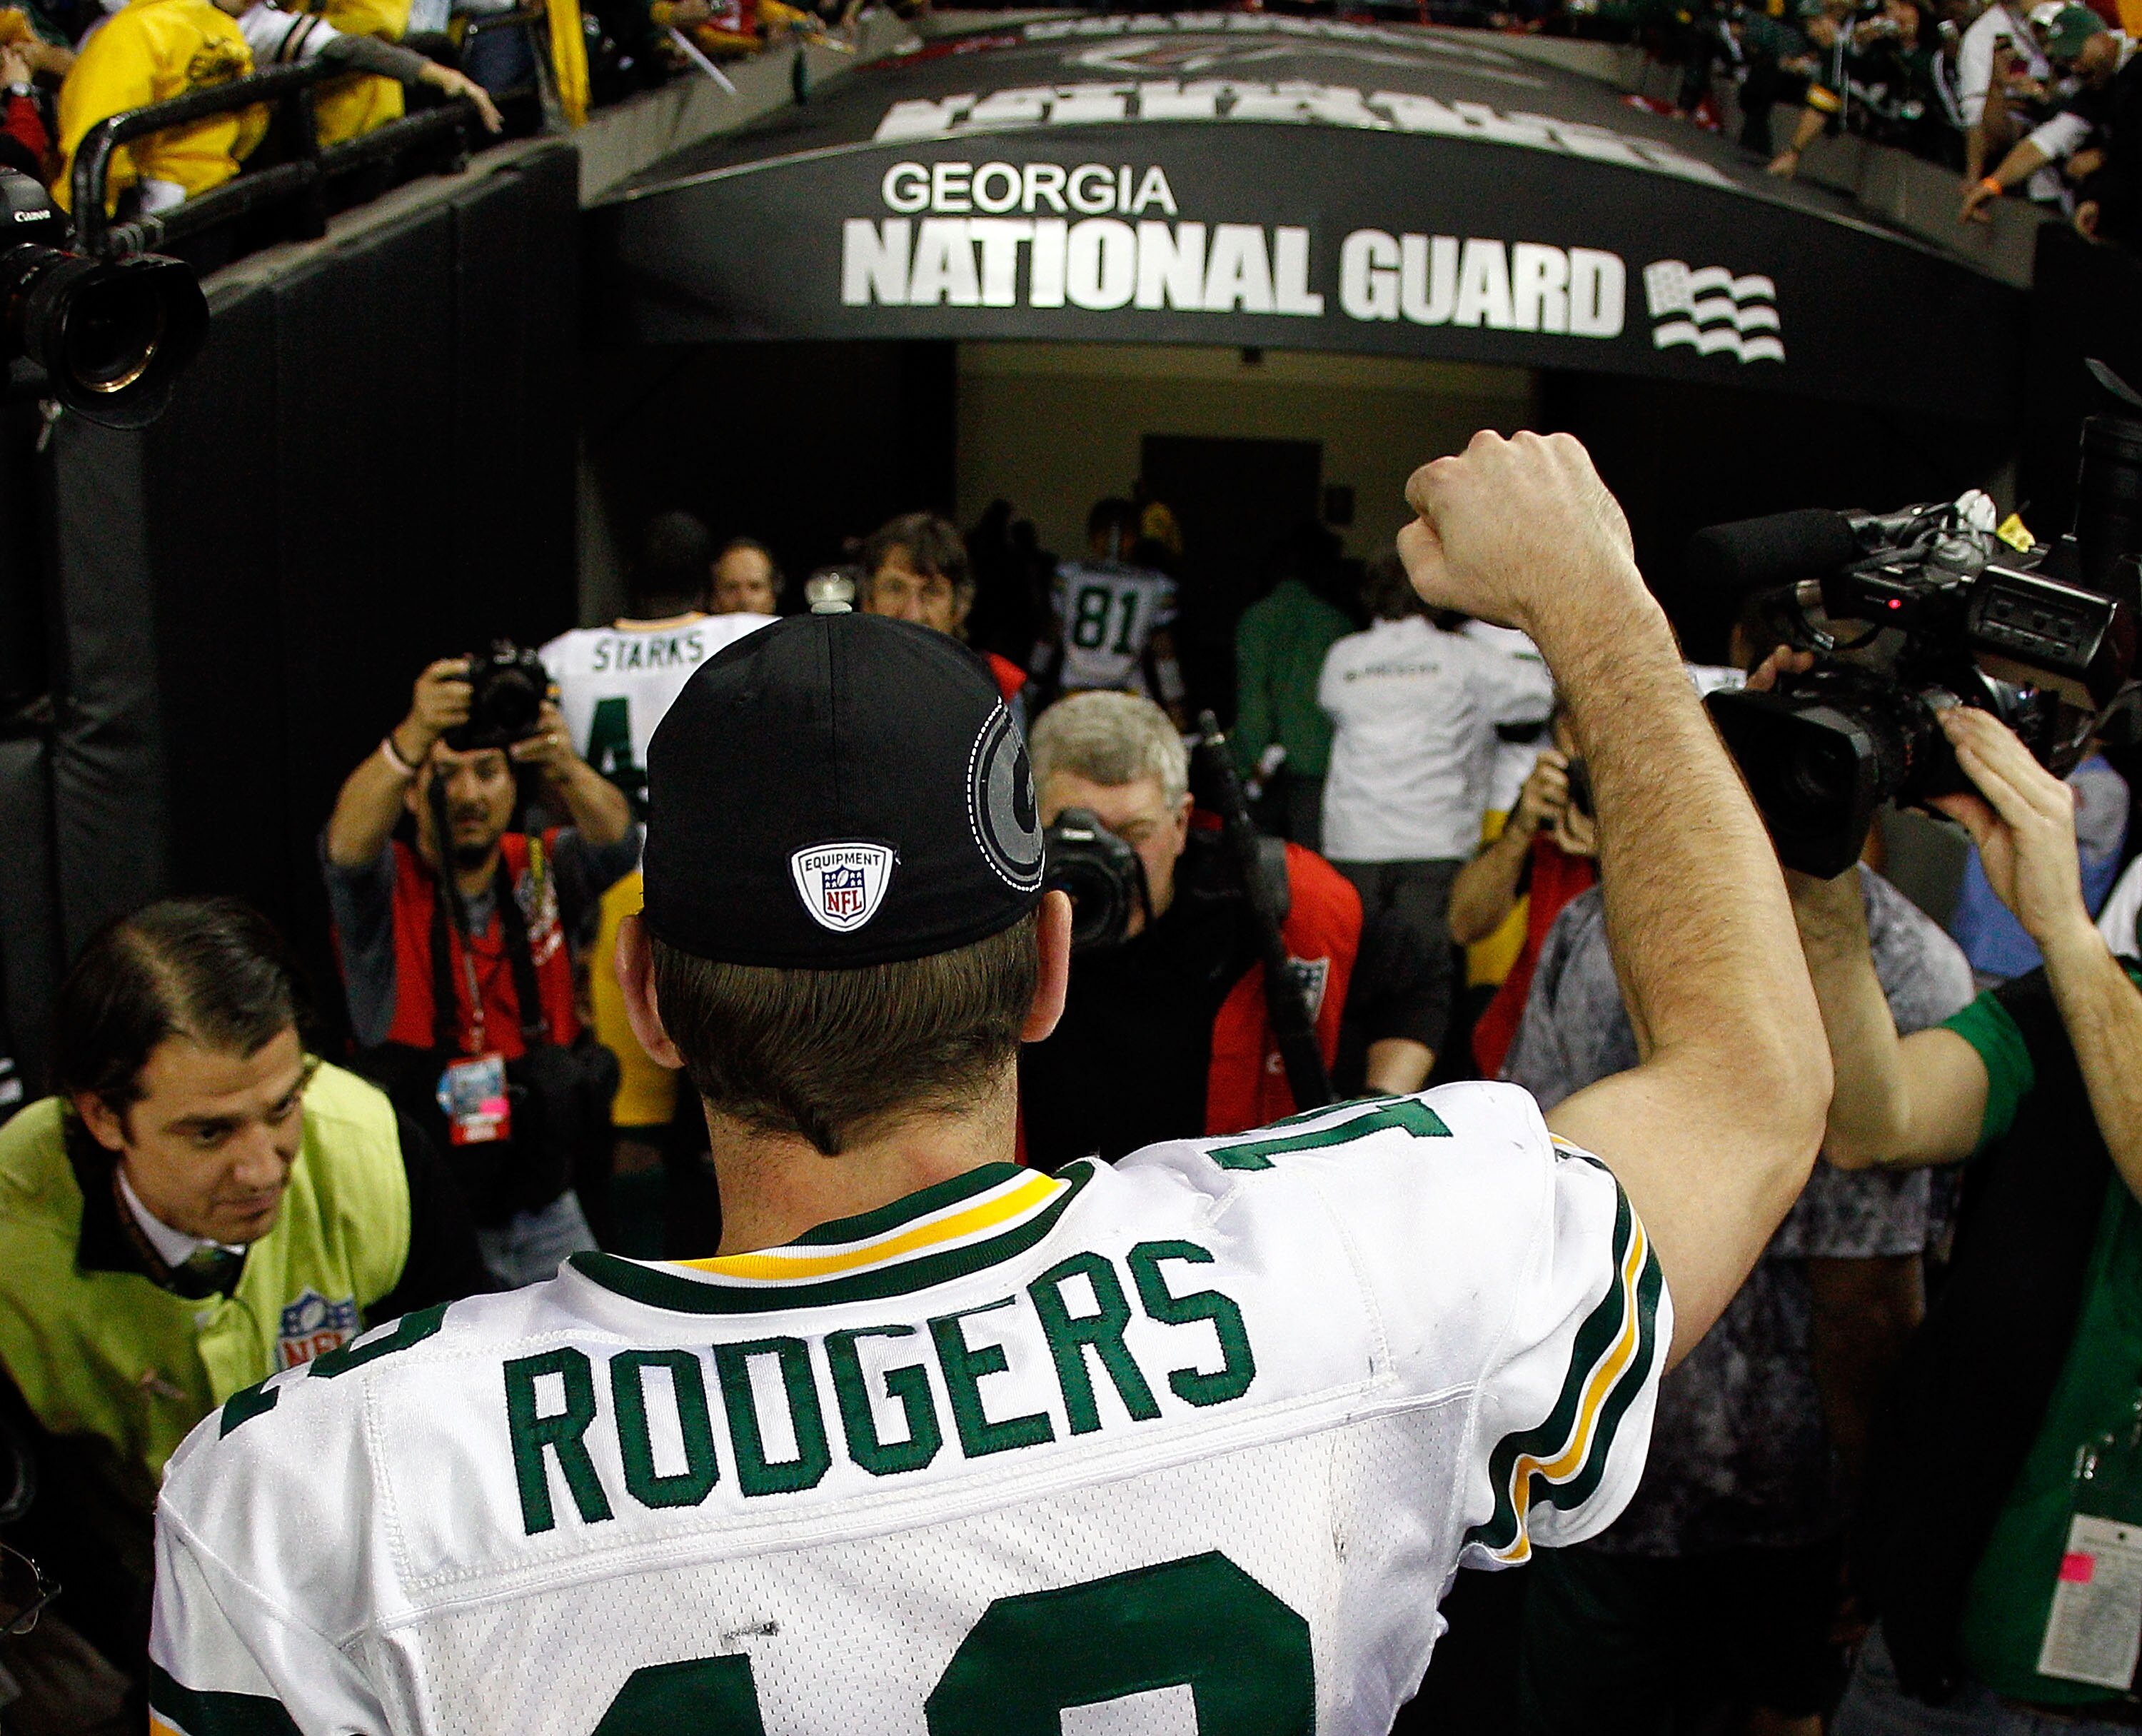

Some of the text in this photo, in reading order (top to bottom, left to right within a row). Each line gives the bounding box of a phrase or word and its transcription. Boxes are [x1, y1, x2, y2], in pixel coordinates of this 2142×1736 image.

[881, 162, 1177, 215] GEORGIA
[840, 216, 1627, 339] NATIONAL GUARD
[1072, 586, 1139, 655] 81
[593, 630, 704, 671] STARKS
[805, 853, 881, 871] EQUIPMENT
[826, 889, 863, 915] NFL
[503, 1239, 1254, 1536] RODGERS
